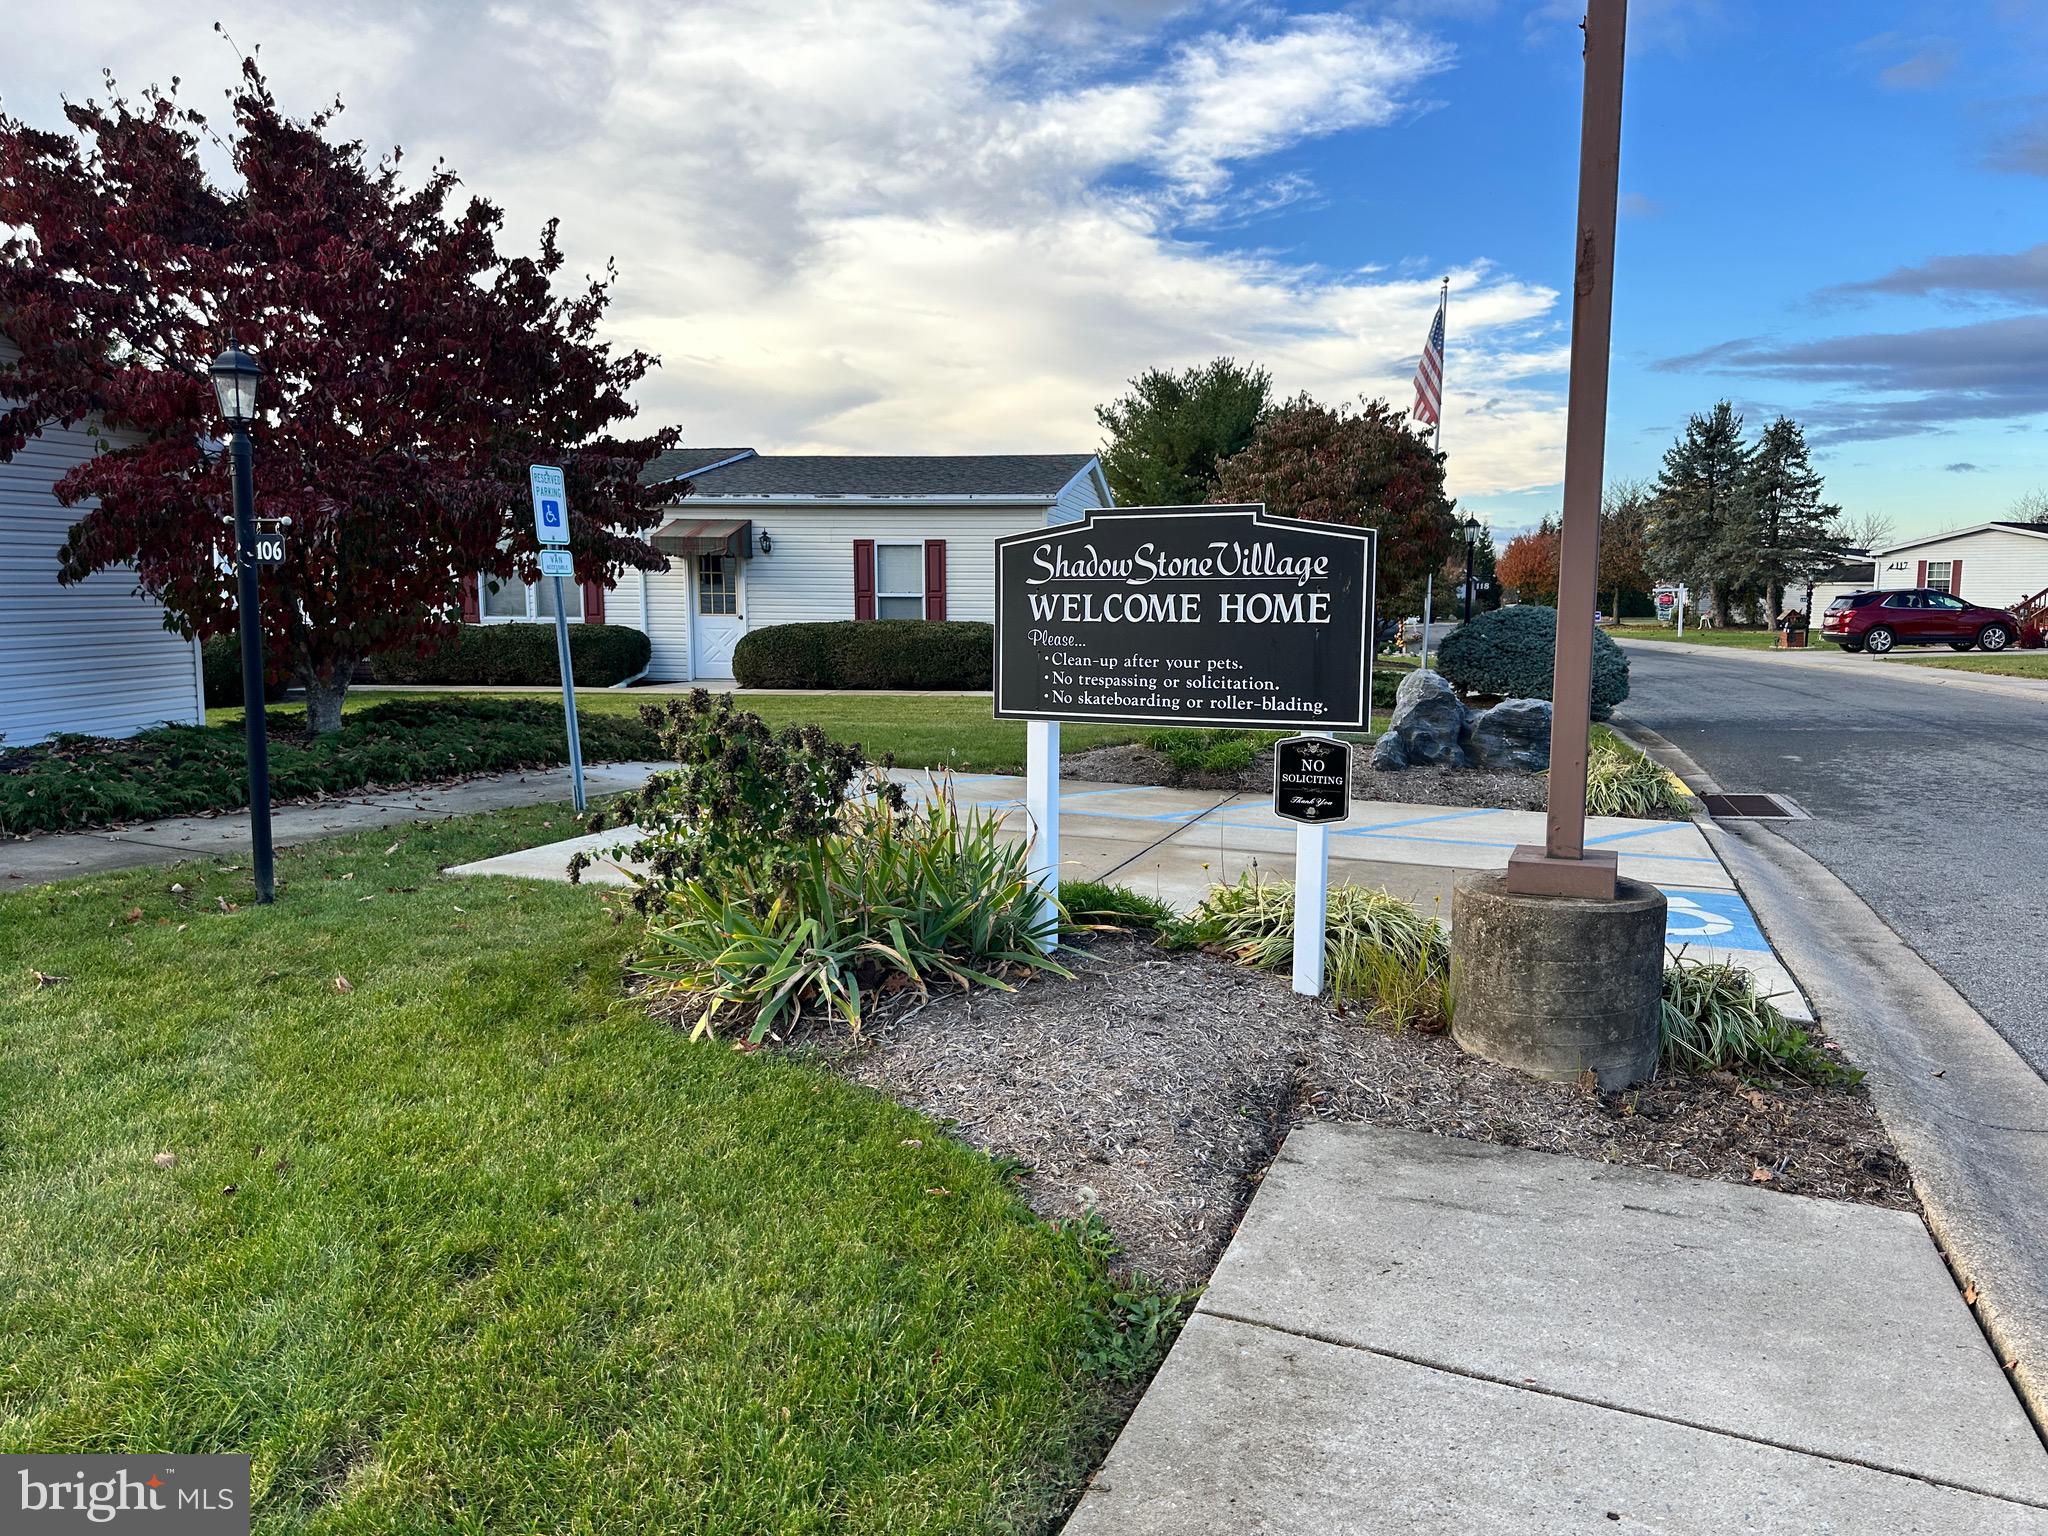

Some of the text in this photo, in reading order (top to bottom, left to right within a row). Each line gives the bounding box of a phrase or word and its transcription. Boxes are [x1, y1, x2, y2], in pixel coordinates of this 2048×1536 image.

[534, 473, 561, 485] RESERVED
[536, 486, 562, 498] PARKING
[256, 541, 282, 561] 106
[550, 556, 563, 564] VAN
[1476, 582, 1490, 590] 118
[1027, 592, 1332, 624] WELCOME HOME
[1027, 629, 1087, 647] Please...
[1051, 652, 1244, 672] Clean-up after your pets.
[1052, 671, 1280, 691] No trespassing or solicitation.
[1052, 689, 1329, 715] No skateboarding or roller-blading.
[1301, 759, 1325, 772] NO
[1282, 773, 1344, 785] SOLICITING
[1290, 796, 1333, 807] Thank You
